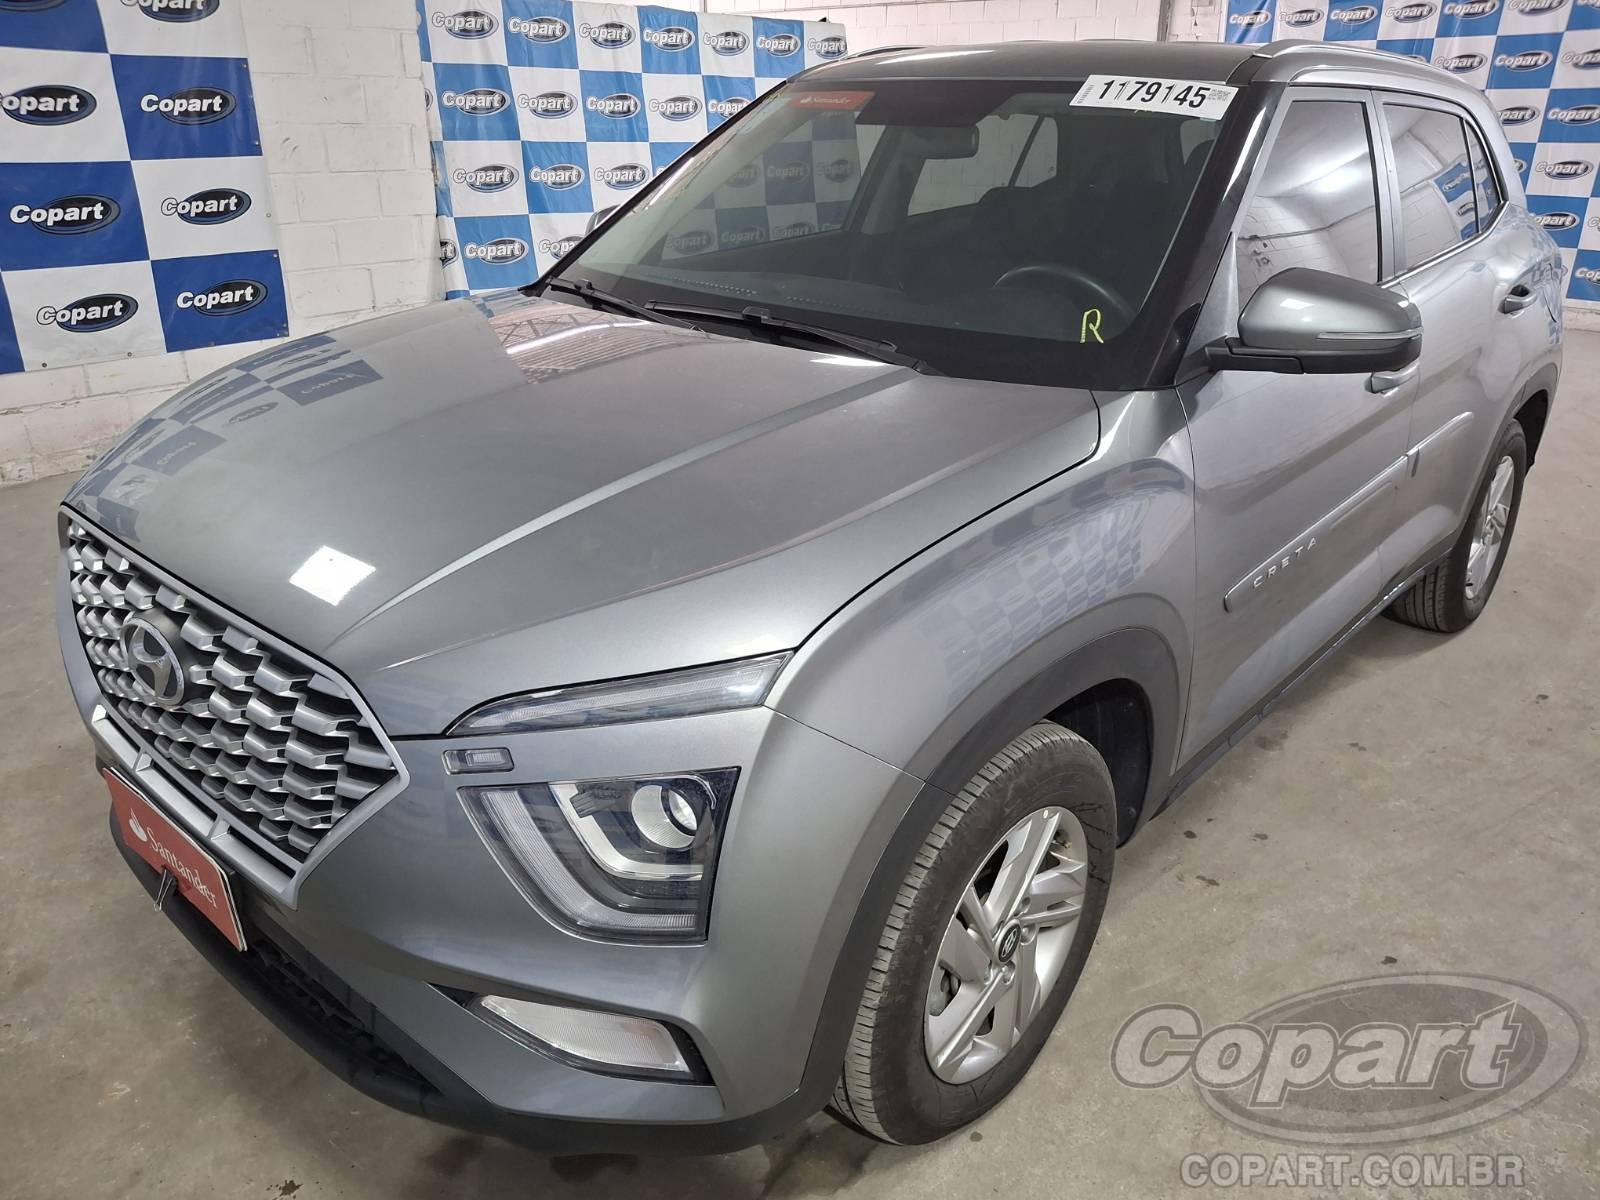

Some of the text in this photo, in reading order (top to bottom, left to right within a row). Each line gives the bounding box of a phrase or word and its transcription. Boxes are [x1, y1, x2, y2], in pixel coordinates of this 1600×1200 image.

[1279, 11, 1319, 23] Copart
[1330, 8, 1371, 21] Copart
[1385, 6, 1430, 19] Copart
[1443, 1, 1492, 16] Copart
[432, 12, 490, 30] Copart
[508, 17, 563, 36] Copart
[1229, 13, 1265, 25] Copart
[579, 24, 628, 41] Copart
[644, 29, 689, 45] Copart
[704, 33, 744, 49] Copart
[757, 36, 796, 51] Copart
[808, 38, 845, 53] Copart
[1434, 54, 1479, 69] Copart
[1495, 53, 1546, 68] Copart
[442, 92, 502, 109] Copart
[1098, 80, 1211, 108] 1179145
[0, 94, 80, 115] opart
[140, 94, 223, 116] Copart
[517, 95, 572, 112] Copart
[586, 97, 635, 114] Copart
[650, 99, 695, 115] Copart
[530, 167, 579, 184] Copart
[594, 168, 642, 184] Copart
[1535, 160, 1586, 177] Copart
[453, 169, 511, 186] Copart
[9, 202, 104, 226] Copart
[161, 195, 238, 217] Copart
[1531, 213, 1573, 227] opart
[465, 242, 521, 259] Copart
[177, 286, 254, 309] Copart
[37, 300, 123, 325] Copart
[1080, 308, 1104, 344] R
[1253, 538, 1317, 588] CRETA
[147, 827, 218, 908] Santander
